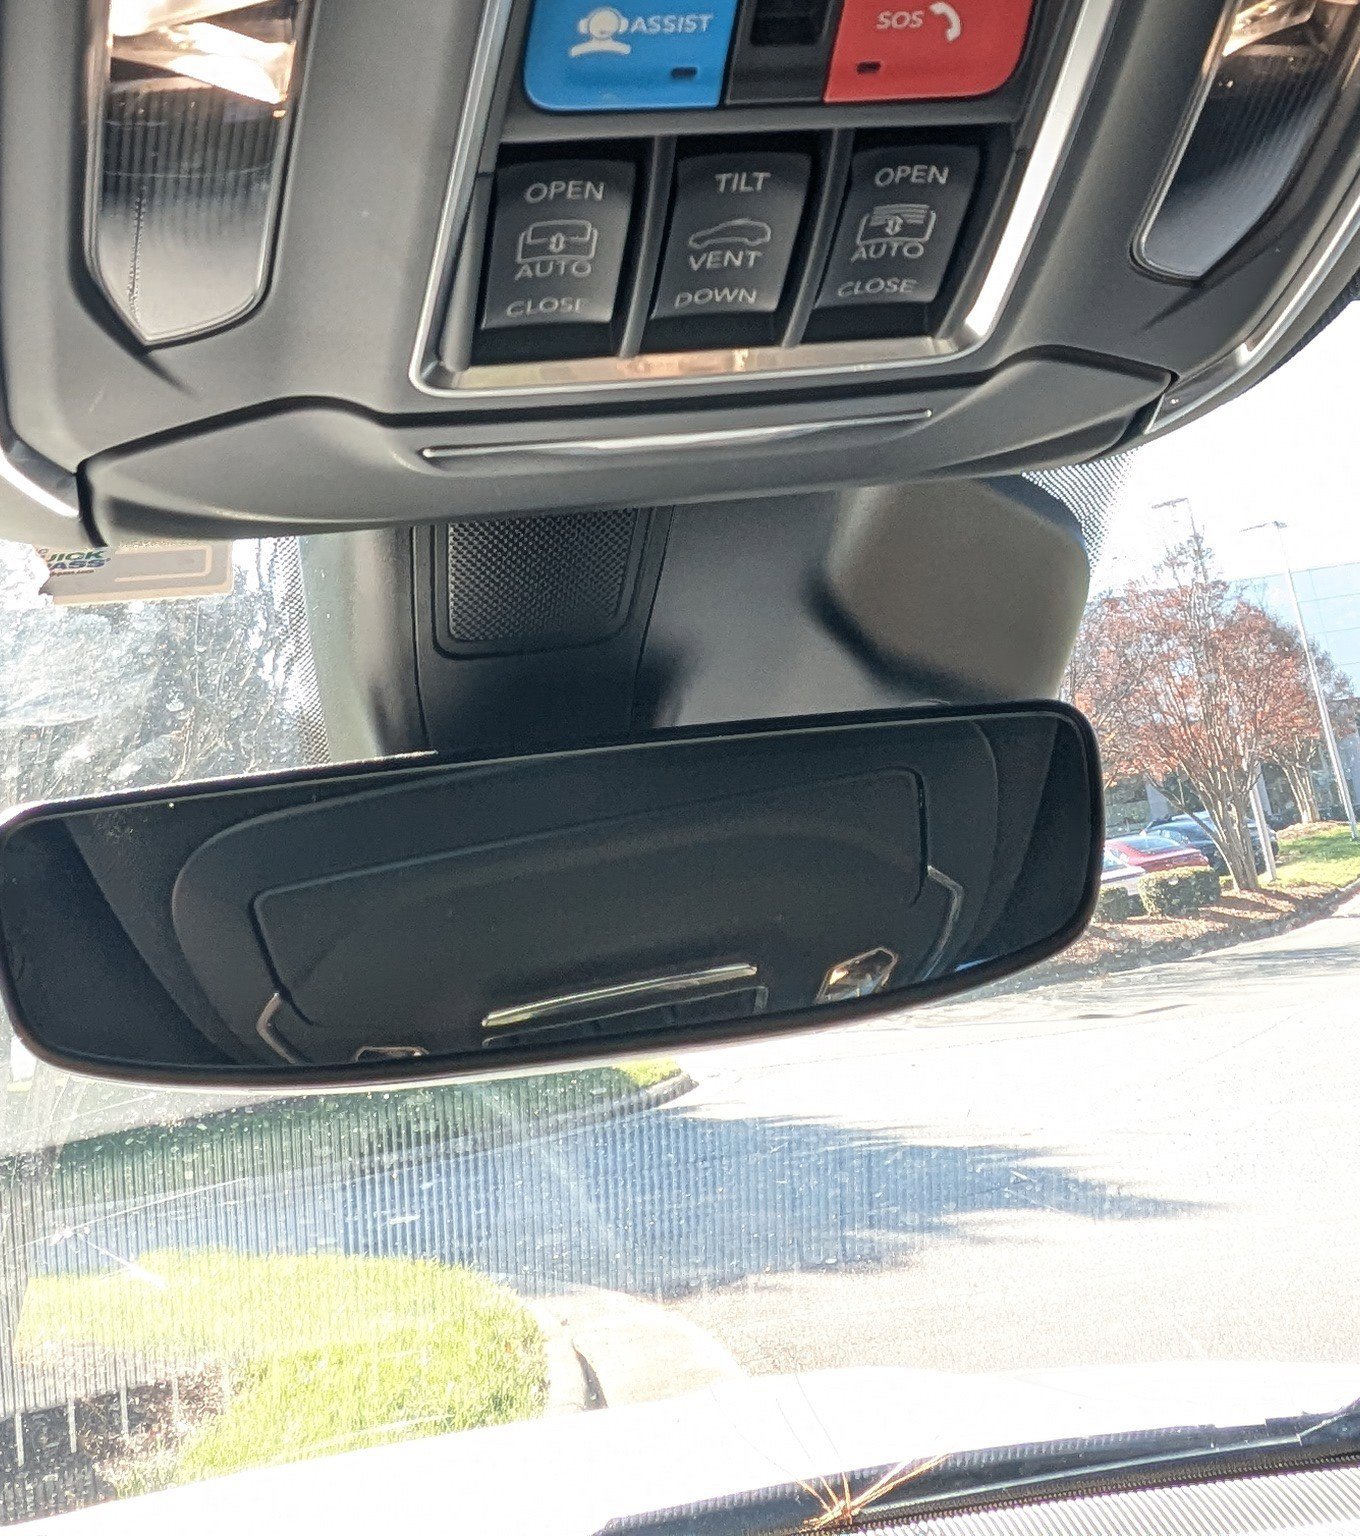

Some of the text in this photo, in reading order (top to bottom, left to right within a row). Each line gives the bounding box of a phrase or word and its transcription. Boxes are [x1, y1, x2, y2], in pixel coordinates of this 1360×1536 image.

[629, 15, 714, 34] ASSIST
[876, 11, 924, 30] SOS
[715, 172, 771, 195] TILT
[875, 164, 949, 187] OPEN
[525, 180, 605, 203] OPEN
[689, 250, 763, 270] VENT
[851, 240, 924, 261] AUTO
[515, 260, 592, 281] AUTO
[674, 286, 757, 308] DOWN
[838, 276, 916, 297] CLOSE
[48, 559, 106, 571] ASS
